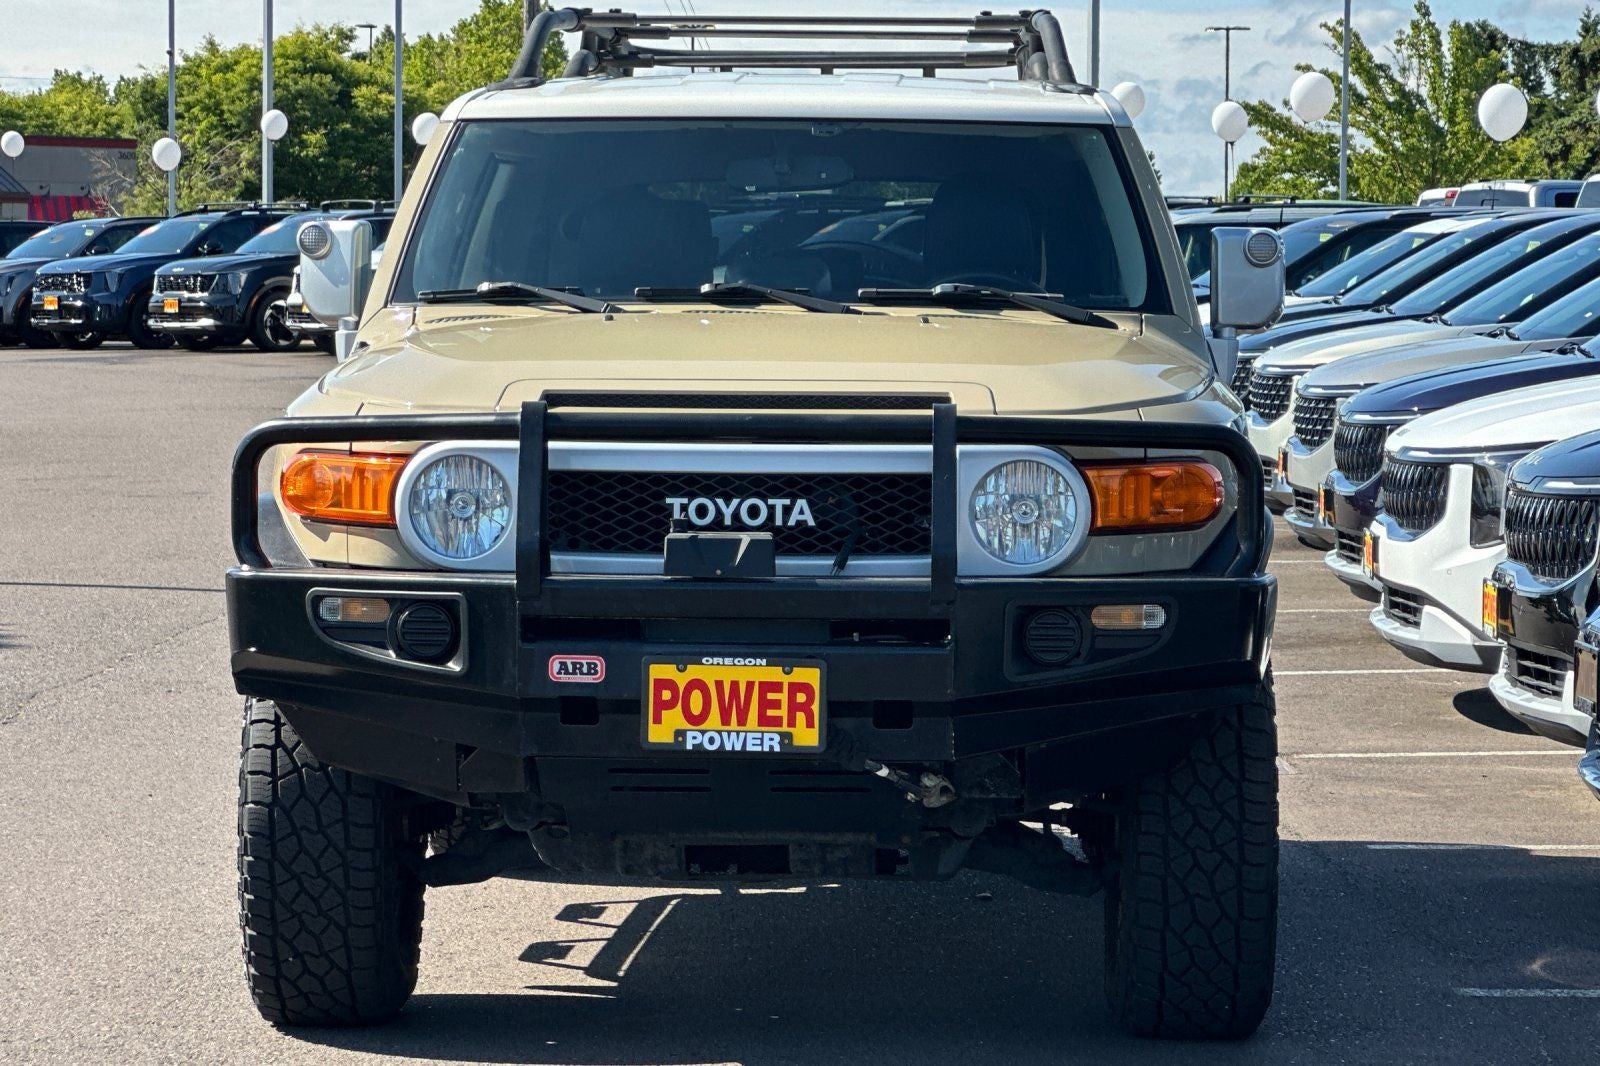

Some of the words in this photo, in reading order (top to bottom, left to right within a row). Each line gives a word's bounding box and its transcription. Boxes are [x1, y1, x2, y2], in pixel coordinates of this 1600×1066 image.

[666, 498, 816, 526] TOYOTA
[556, 661, 599, 676] ARB
[702, 657, 767, 666] OREGON
[652, 678, 816, 728] POWER
[686, 731, 781, 752] POWER
